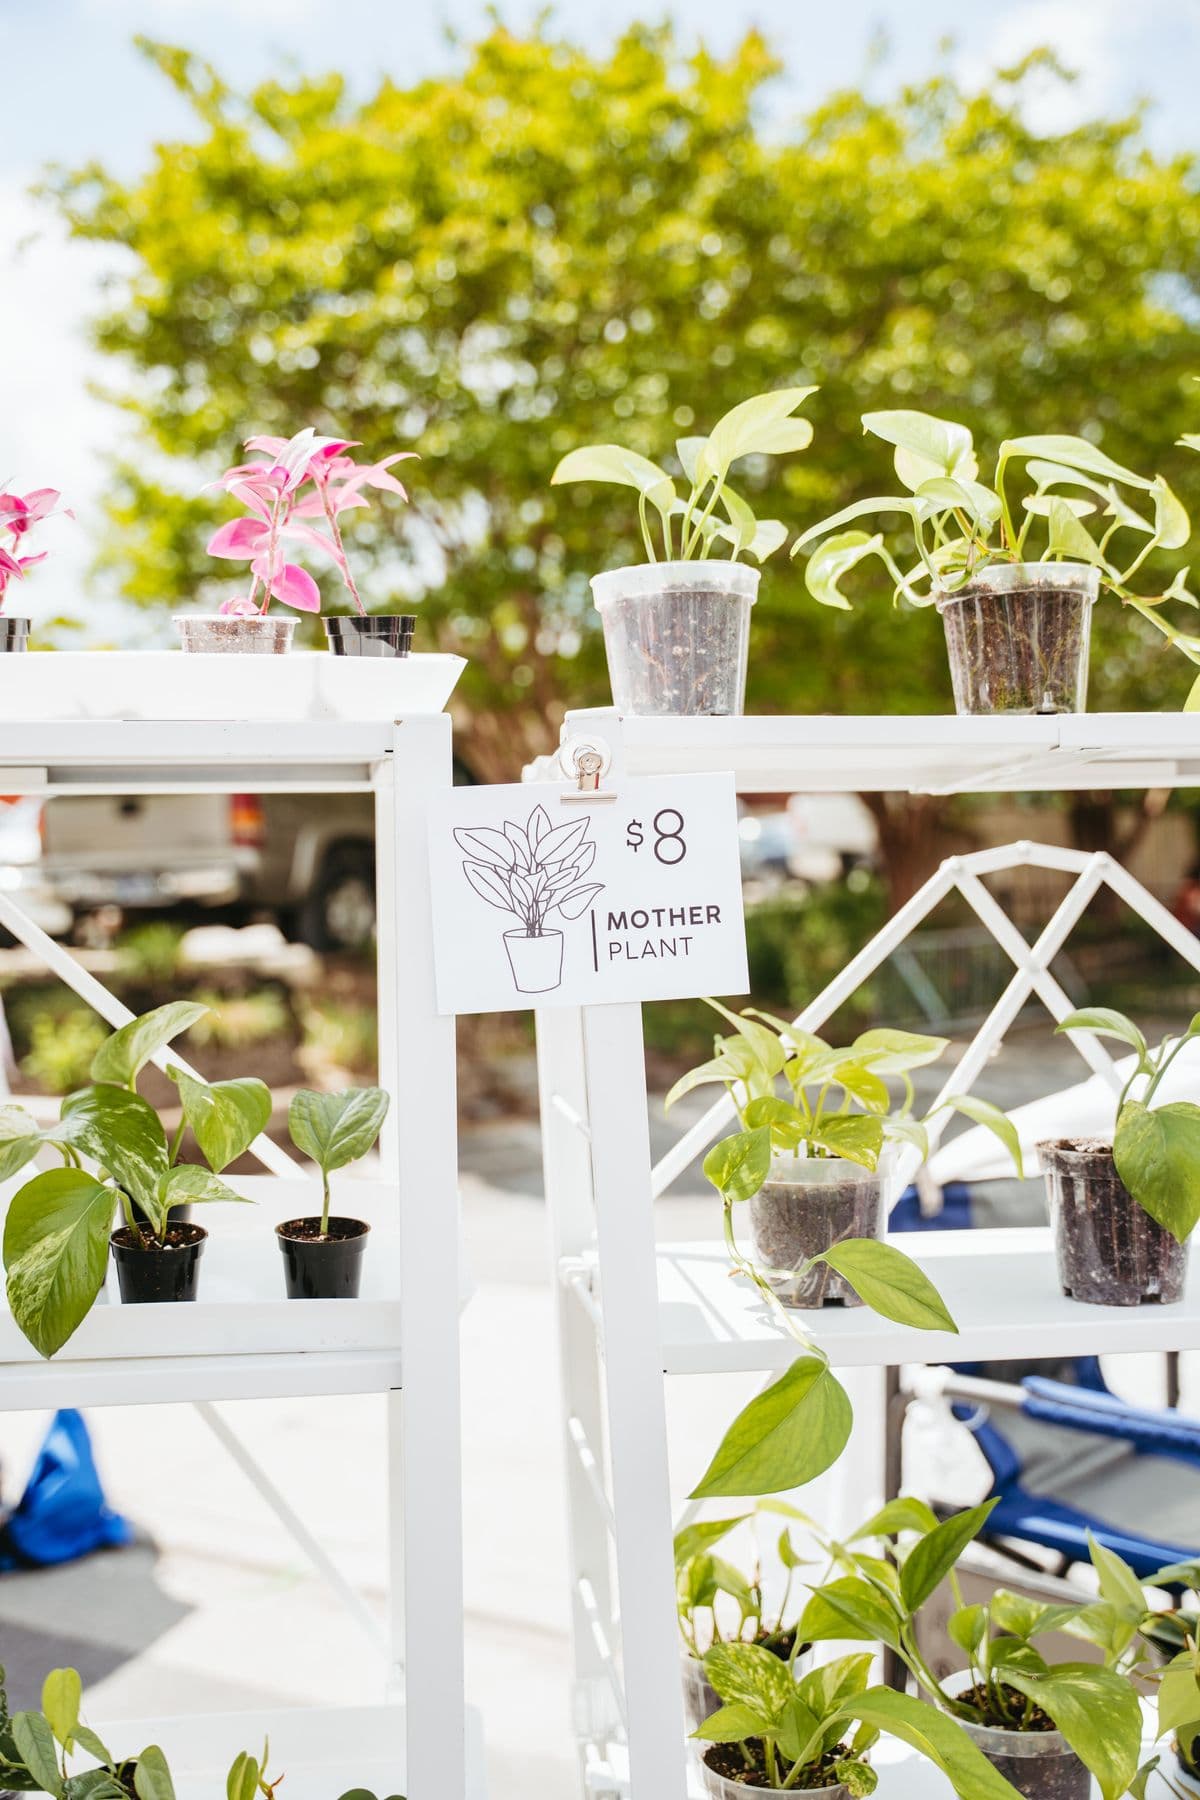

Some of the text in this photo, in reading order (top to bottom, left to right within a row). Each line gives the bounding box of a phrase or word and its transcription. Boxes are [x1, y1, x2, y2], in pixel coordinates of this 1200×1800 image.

[626, 808, 687, 866] $8
[607, 905, 722, 931] MOTHER
[608, 936, 693, 961] PLANT
